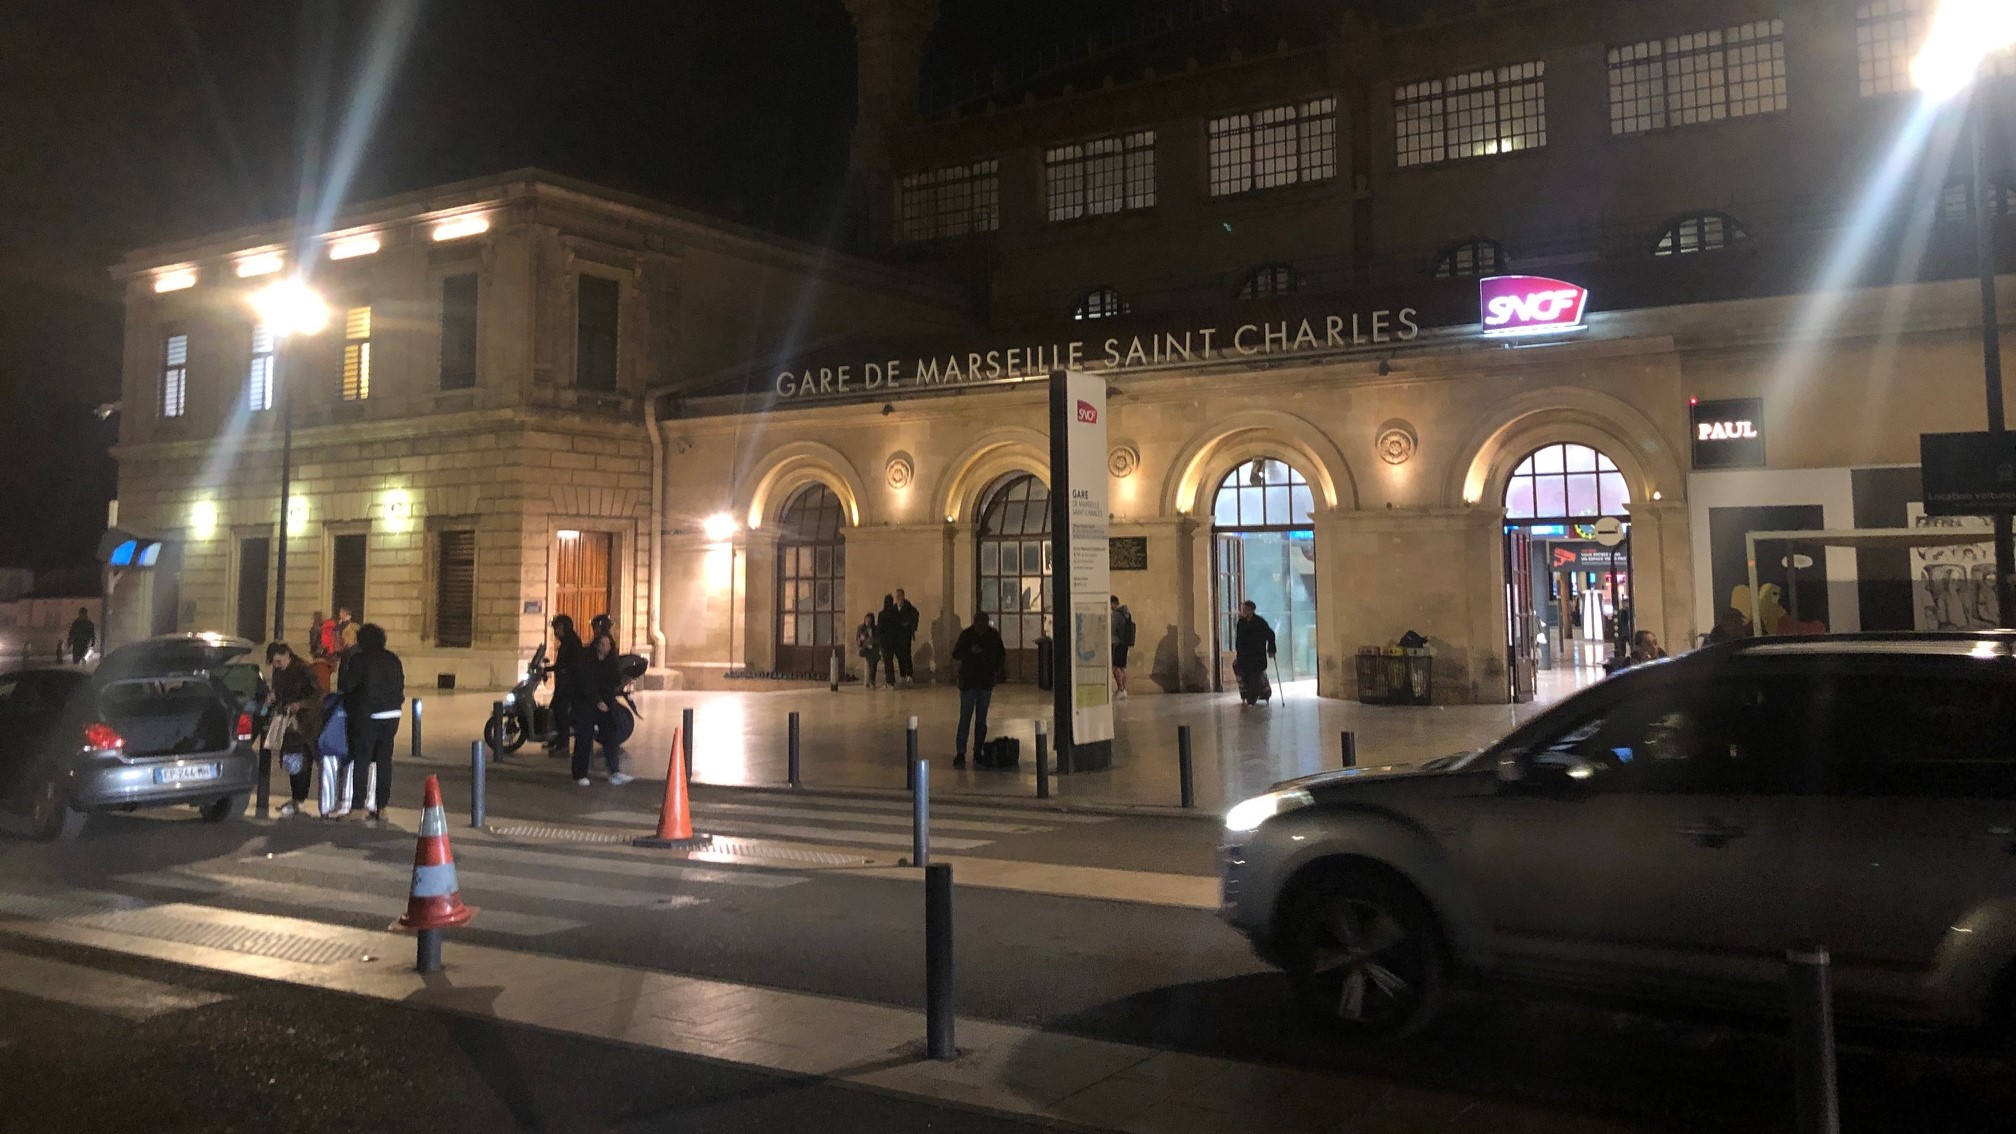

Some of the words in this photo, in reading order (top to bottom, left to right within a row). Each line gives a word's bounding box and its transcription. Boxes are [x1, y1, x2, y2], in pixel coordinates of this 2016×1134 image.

[1485, 289, 1579, 326] SNCF
[776, 365, 851, 398] GARE
[865, 360, 900, 390] DE
[916, 341, 1084, 386] MARSEILLE
[1103, 328, 1217, 369] SAINT
[1233, 307, 1419, 356] CHARLES
[1078, 408, 1097, 421] SNCF
[1697, 421, 1758, 441] PAUL
[1072, 488, 1089, 501] GARE
